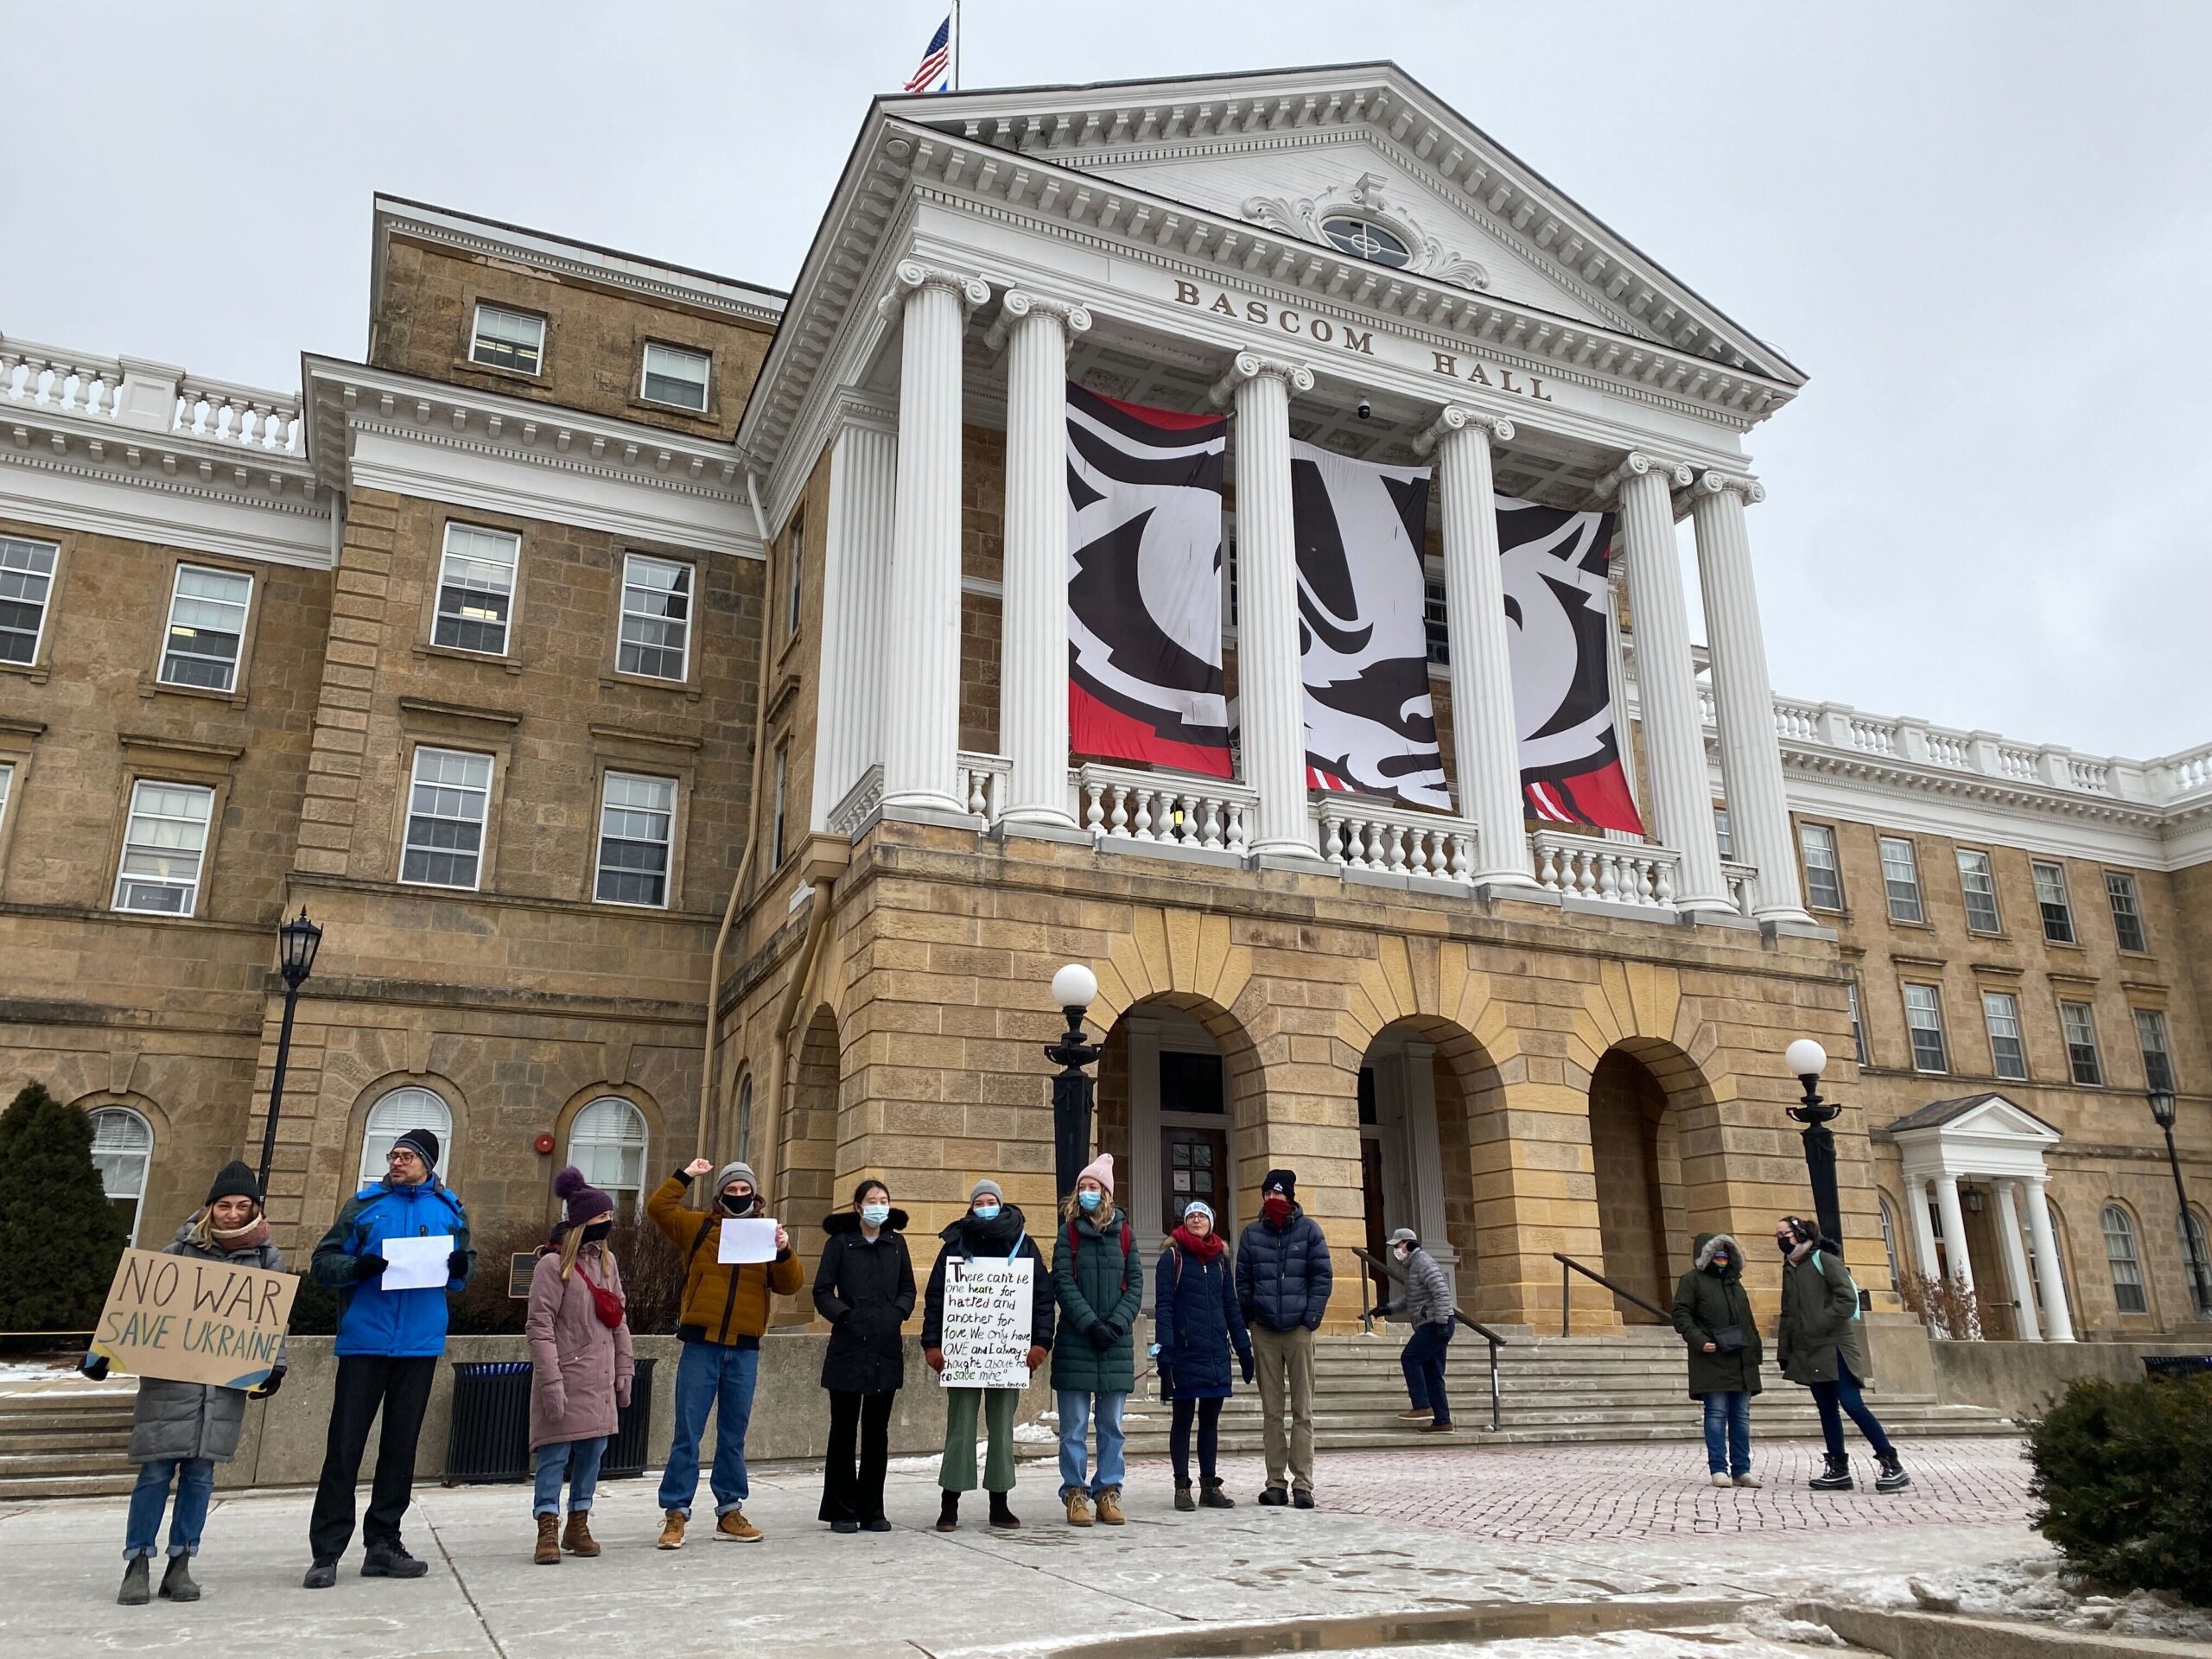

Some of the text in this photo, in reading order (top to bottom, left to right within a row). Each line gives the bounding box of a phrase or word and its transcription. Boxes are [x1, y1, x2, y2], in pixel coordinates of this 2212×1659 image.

[1173, 279, 1552, 402] BASCOM HALL
[1016, 1274, 1029, 1285] be
[117, 1256, 280, 1326] NO WAR
[969, 1283, 994, 1294] heart
[1000, 1285, 1016, 1297] for
[948, 1294, 1015, 1311] hatred and
[946, 1312, 1015, 1327] another for
[98, 1311, 177, 1350] SAVE
[970, 1325, 985, 1340] We
[1011, 1329, 1031, 1341] have
[943, 1341, 969, 1357] ONE
[971, 1345, 988, 1355] and
[995, 1344, 1029, 1360] always
[984, 1359, 1014, 1369] about
[941, 1373, 952, 1382] to
[953, 1370, 976, 1381] save
